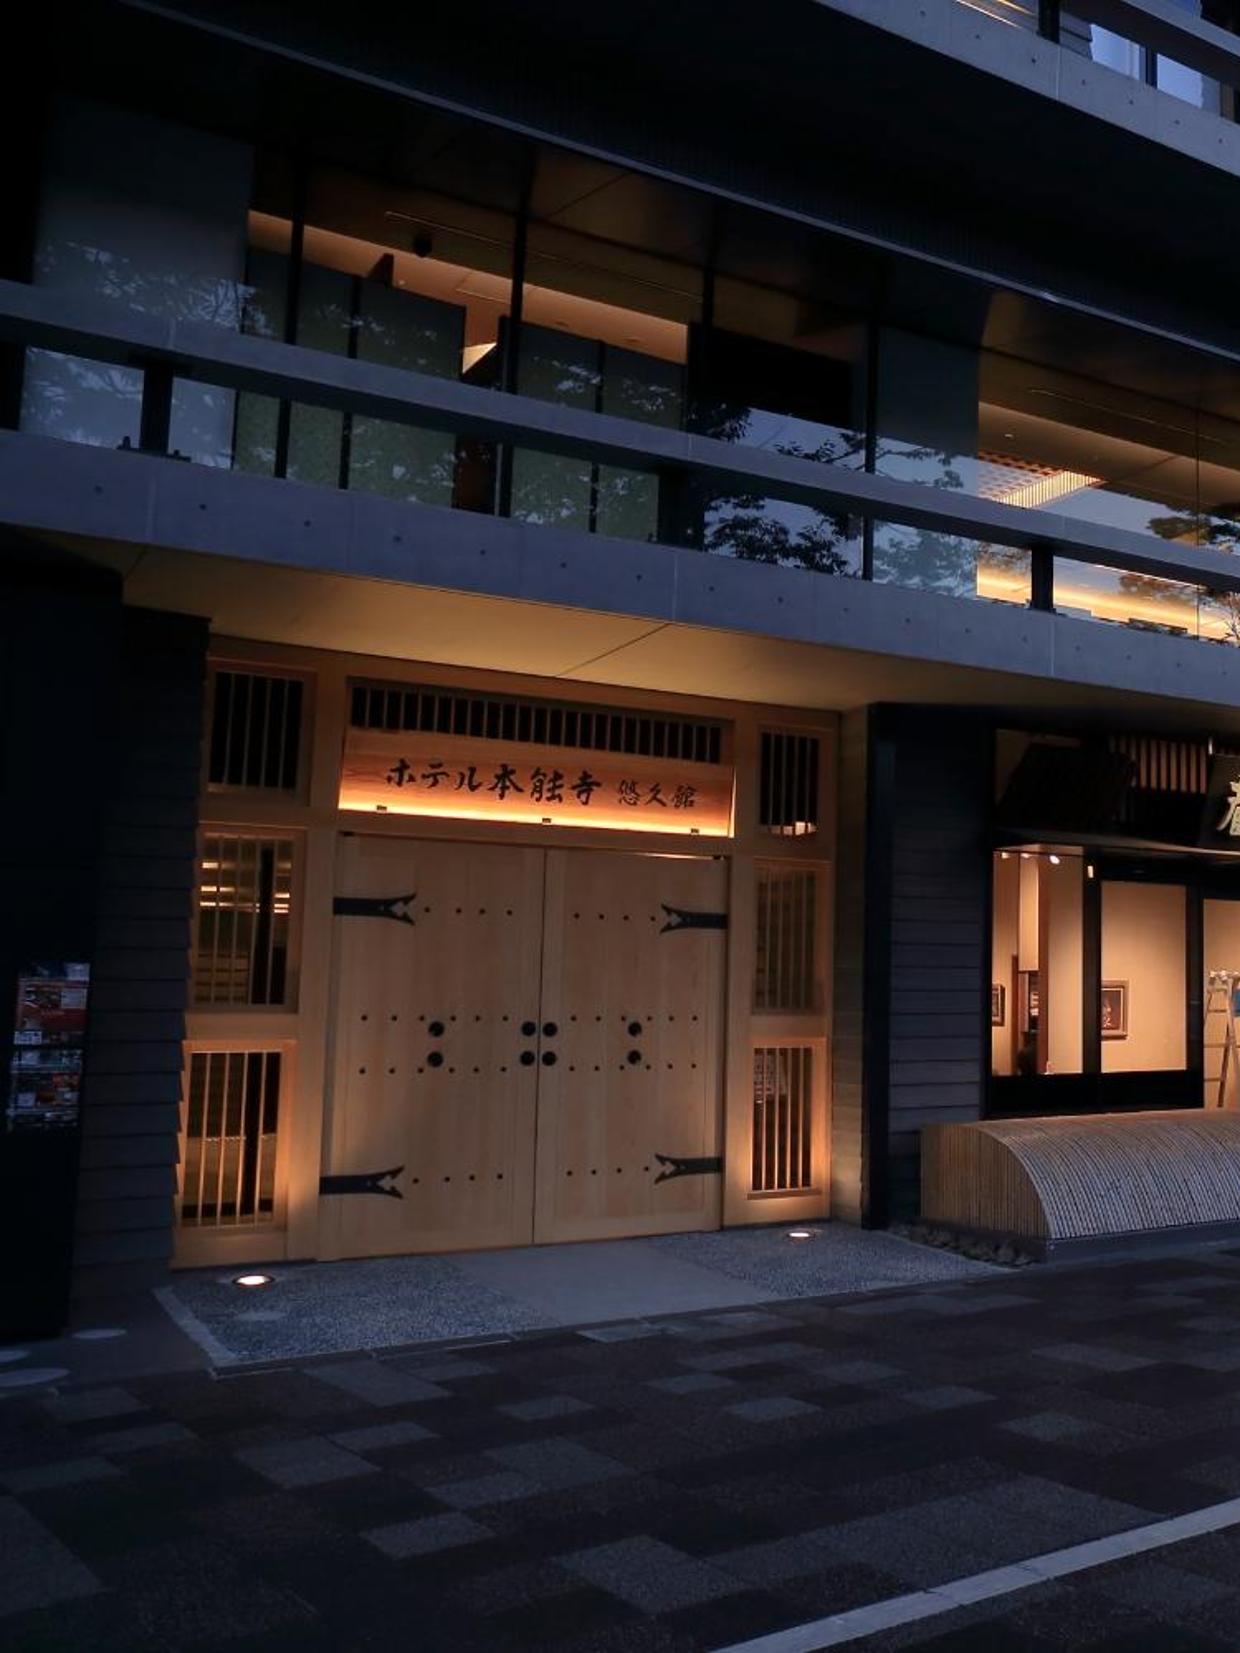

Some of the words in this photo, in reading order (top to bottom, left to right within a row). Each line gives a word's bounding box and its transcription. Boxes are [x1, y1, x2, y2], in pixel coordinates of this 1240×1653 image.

[386, 758, 602, 806] ホテル本能寺
